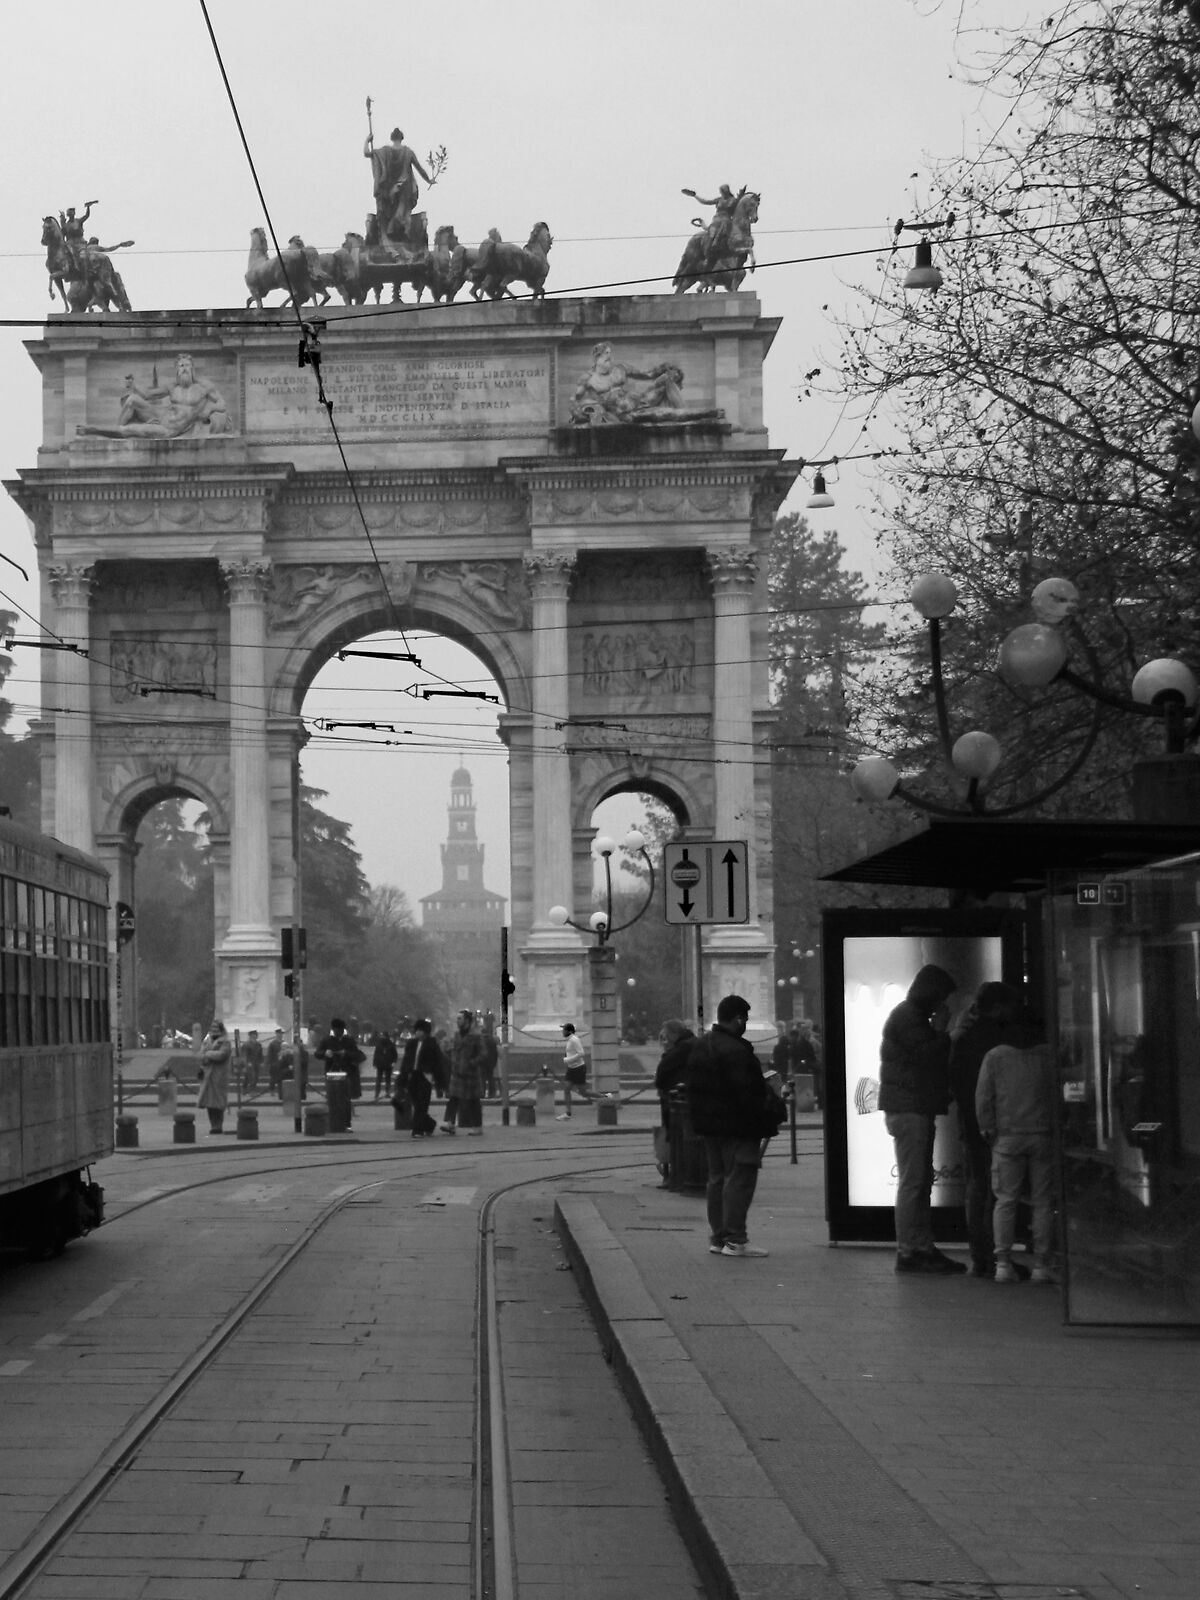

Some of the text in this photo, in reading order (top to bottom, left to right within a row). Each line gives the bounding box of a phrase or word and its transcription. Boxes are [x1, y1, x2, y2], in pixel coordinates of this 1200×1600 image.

[310, 364, 364, 374] TRANDO
[438, 359, 485, 370] GLORIOSE
[249, 376, 309, 386] NAPOLEONE
[349, 373, 398, 383] VITTORIO
[405, 370, 460, 381] EMANUELE
[482, 368, 545, 379] LIBERATORI
[268, 386, 308, 396] MILANO
[315, 384, 368, 395] EULTANTE
[432, 382, 445, 391] DA
[452, 381, 489, 390] QUESTI
[494, 379, 527, 389] MARMI
[338, 391, 455, 403] LE IMPRONTE SERVILI
[297, 405, 308, 414] VI
[476, 400, 511, 410] ITALIA
